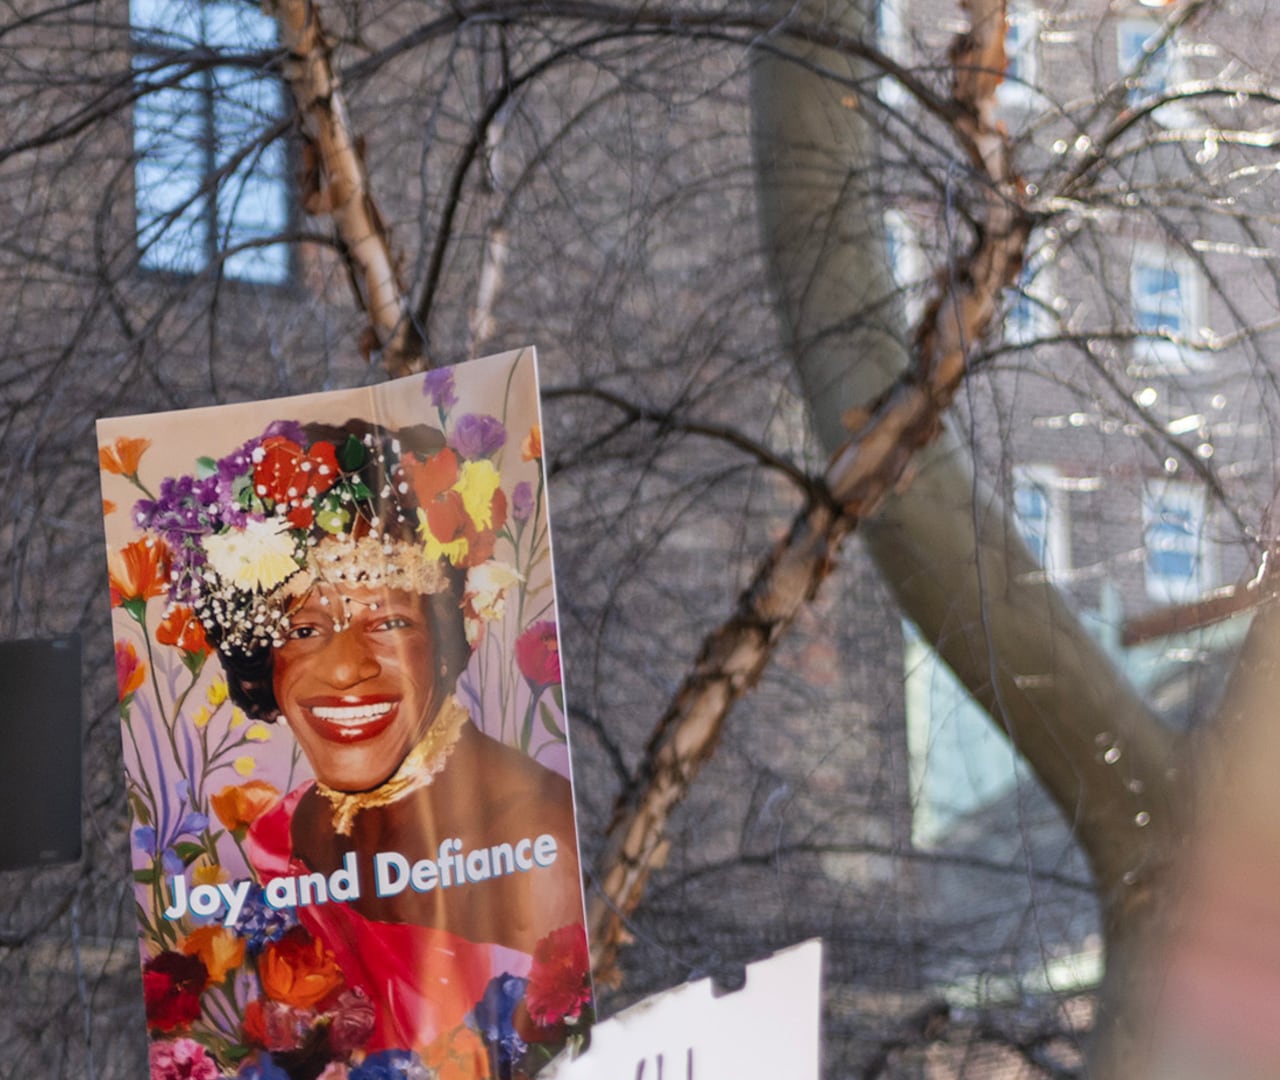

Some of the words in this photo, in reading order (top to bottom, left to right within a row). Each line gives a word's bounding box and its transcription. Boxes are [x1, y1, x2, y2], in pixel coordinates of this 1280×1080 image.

[163, 874, 252, 928] Joy
[263, 851, 360, 909] and
[375, 832, 559, 898] Defiance
